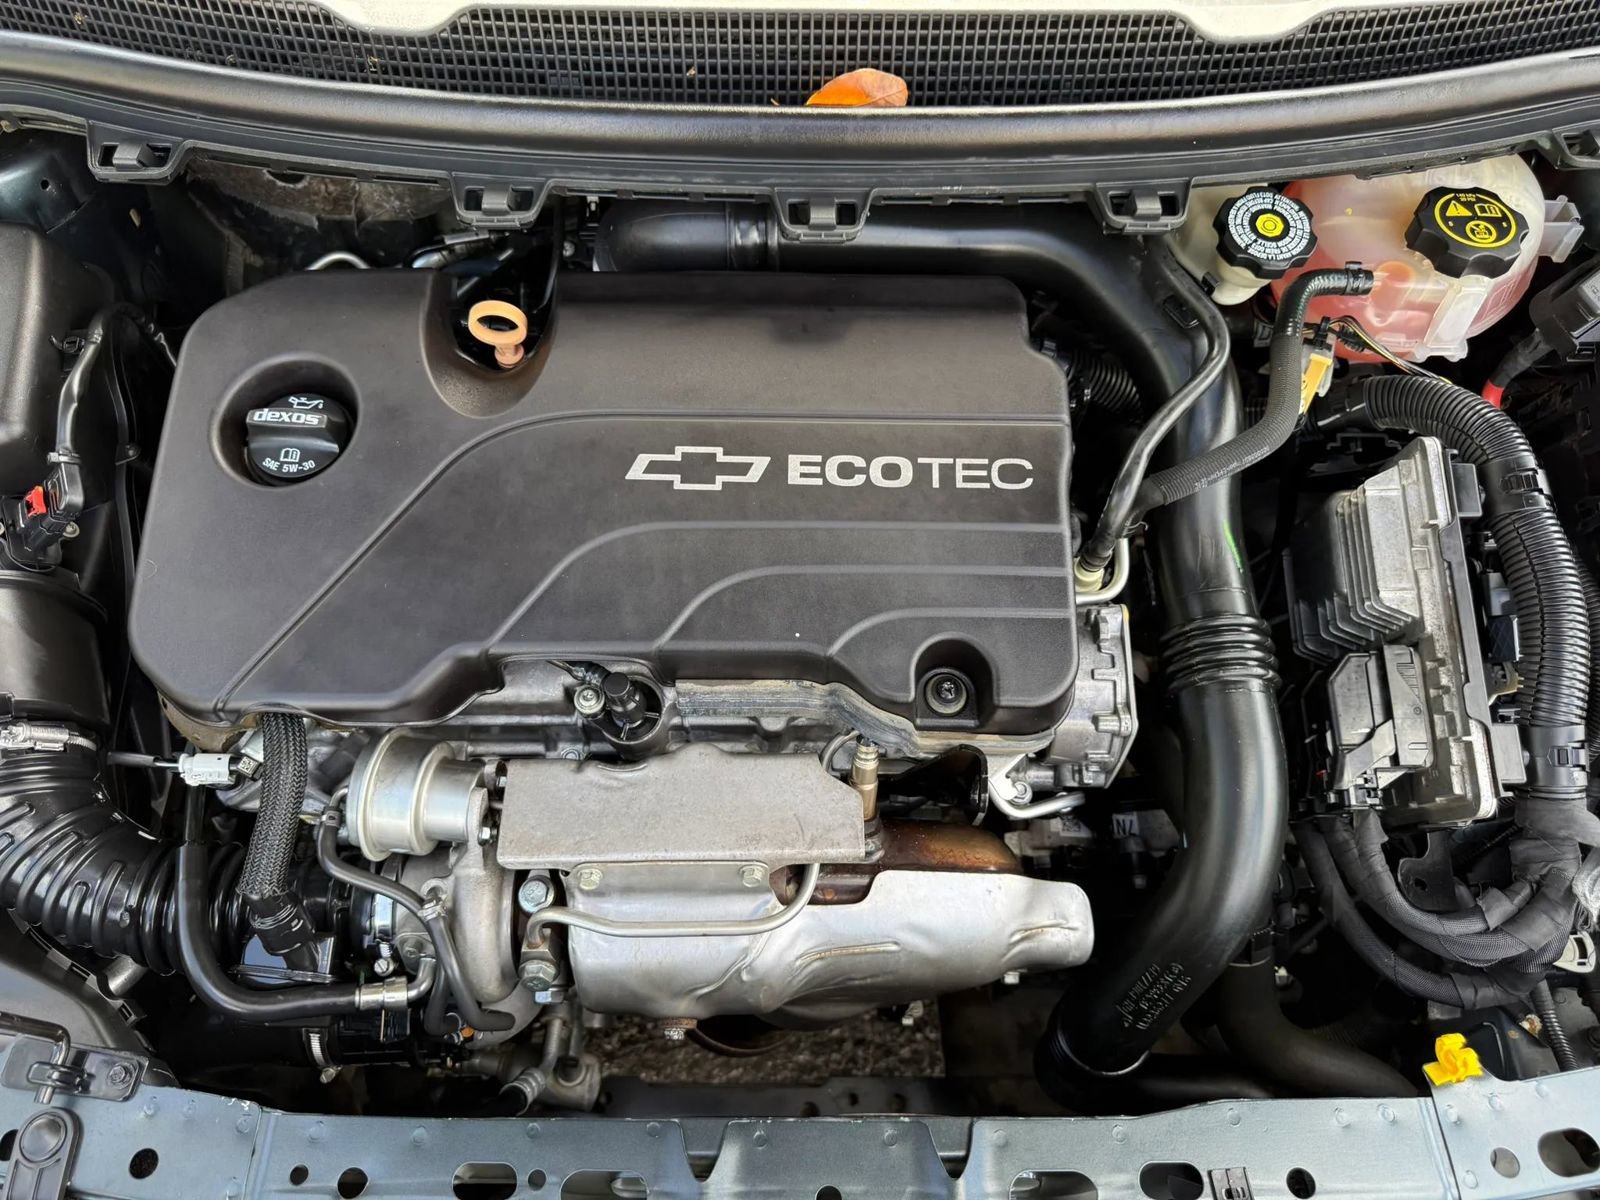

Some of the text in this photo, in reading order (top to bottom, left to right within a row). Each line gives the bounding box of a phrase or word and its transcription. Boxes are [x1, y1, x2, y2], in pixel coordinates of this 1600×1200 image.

[253, 408, 322, 425] dexos
[262, 457, 316, 473] SAE 5W-30
[787, 454, 1034, 490] ECOTEC
